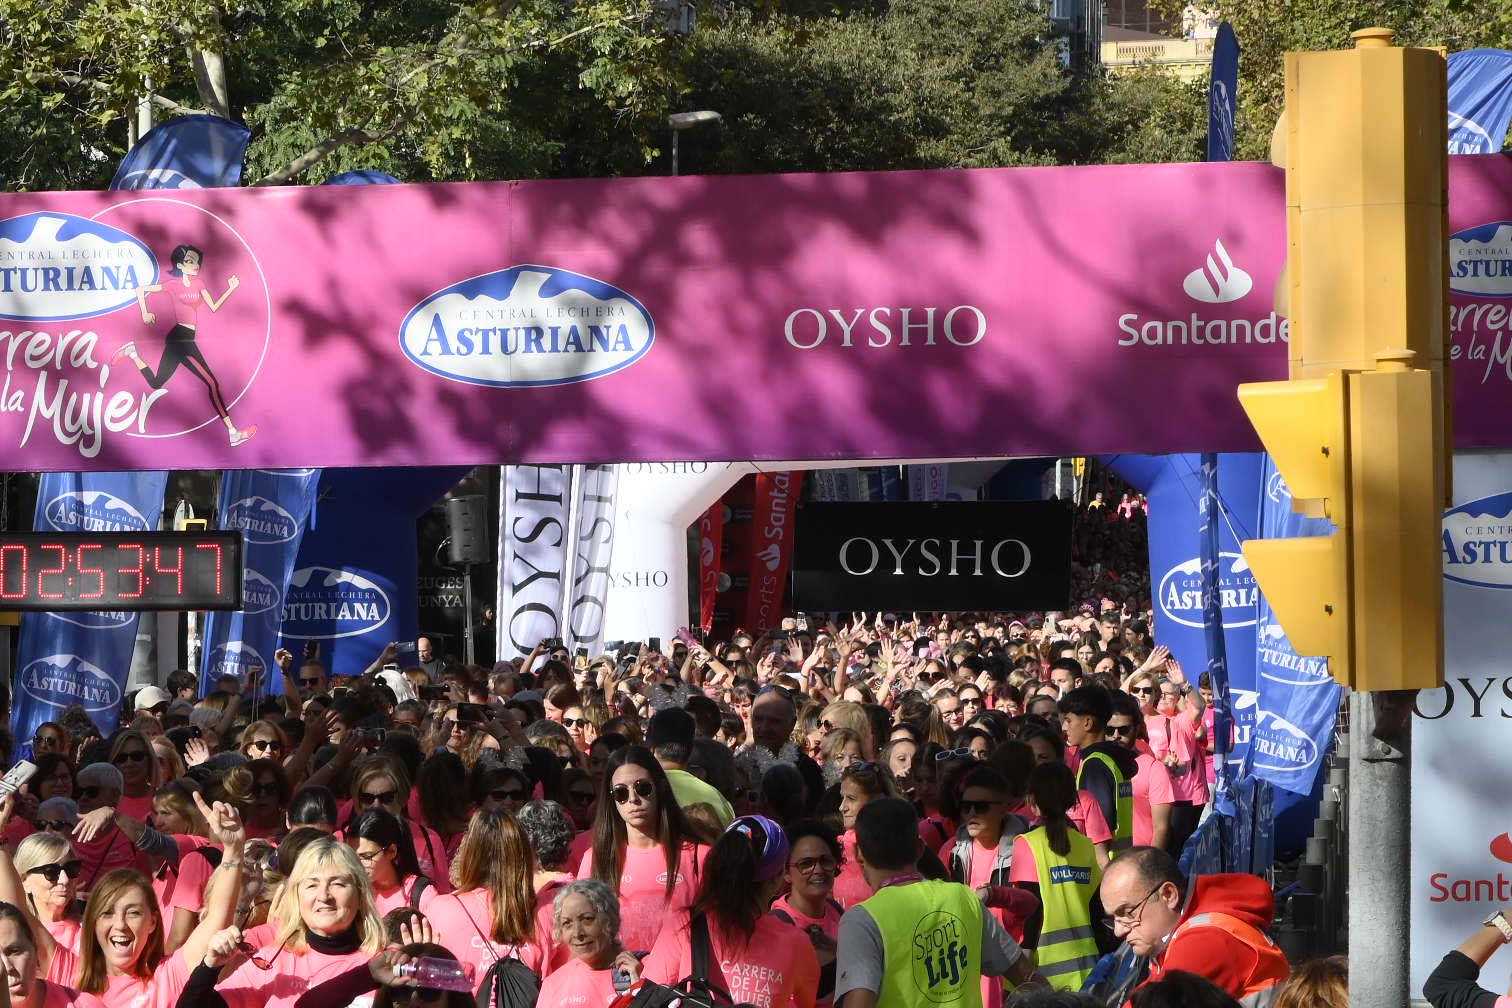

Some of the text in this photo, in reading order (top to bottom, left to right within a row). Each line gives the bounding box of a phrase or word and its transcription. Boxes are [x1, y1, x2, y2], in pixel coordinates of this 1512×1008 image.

[61, 248, 136, 260] LECHERA
[459, 306, 626, 321] CENTRAL LECHERA
[784, 305, 987, 349] OYSHO
[1118, 313, 1288, 346] Santande
[420, 312, 634, 356] ASTURIANA
[1468, 333, 1486, 360] la
[0, 372, 25, 412] la
[19, 364, 169, 458] Mujer
[765, 471, 790, 541] Santa
[509, 464, 564, 656] OYSH
[571, 464, 614, 644] OYSH
[839, 537, 1031, 578] OYSHO
[1442, 529, 1512, 564] ASTU
[0, 544, 222, 598] 02:53:47
[607, 570, 668, 588] YSHO
[280, 602, 380, 621] STURIANA
[28, 668, 111, 704] ASTURIANA
[1430, 872, 1512, 902] Sant
[915, 917, 959, 960] Sport
[720, 960, 784, 984] CARRERA
[925, 941, 967, 988] Life
[732, 975, 771, 995] DE LA
